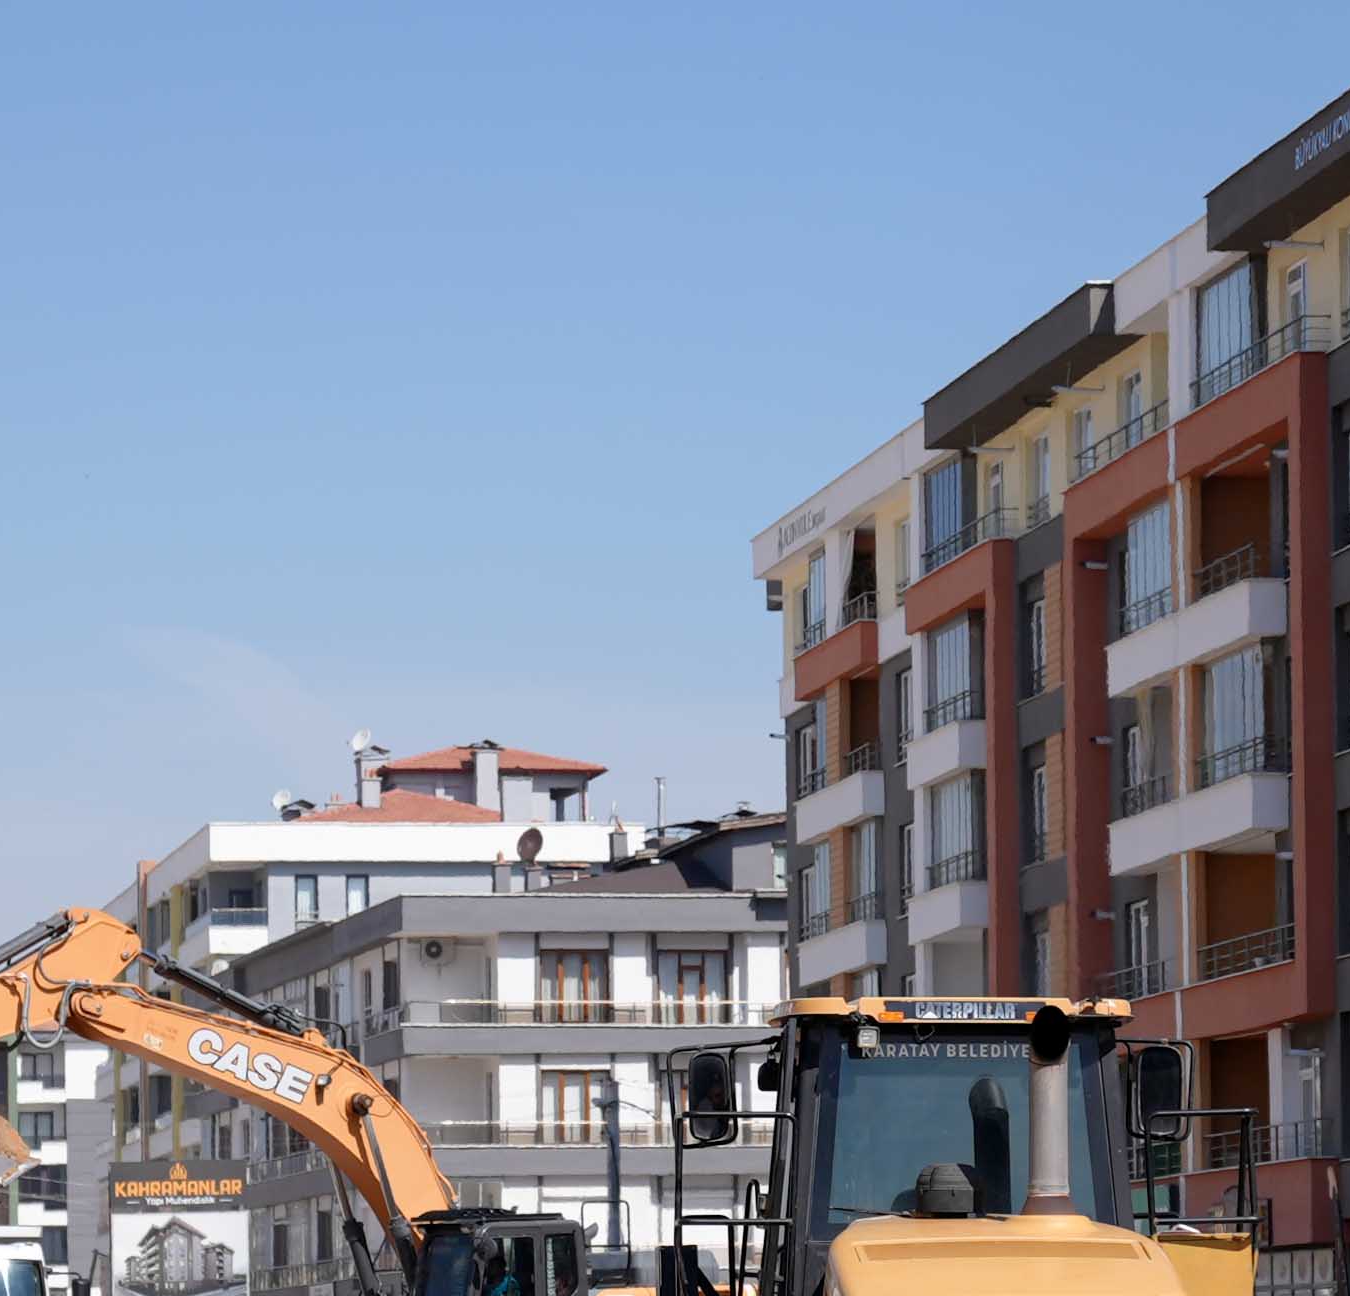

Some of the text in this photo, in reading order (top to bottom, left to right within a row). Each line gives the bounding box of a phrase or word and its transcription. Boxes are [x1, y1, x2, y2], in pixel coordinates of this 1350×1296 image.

[915, 1001, 1016, 1019] CATERPILLAR
[861, 1040, 1030, 1058] KARATAY BELEDİYE
[187, 1028, 314, 1104] CASE
[115, 1179, 242, 1197] KAHRAMANLAR
